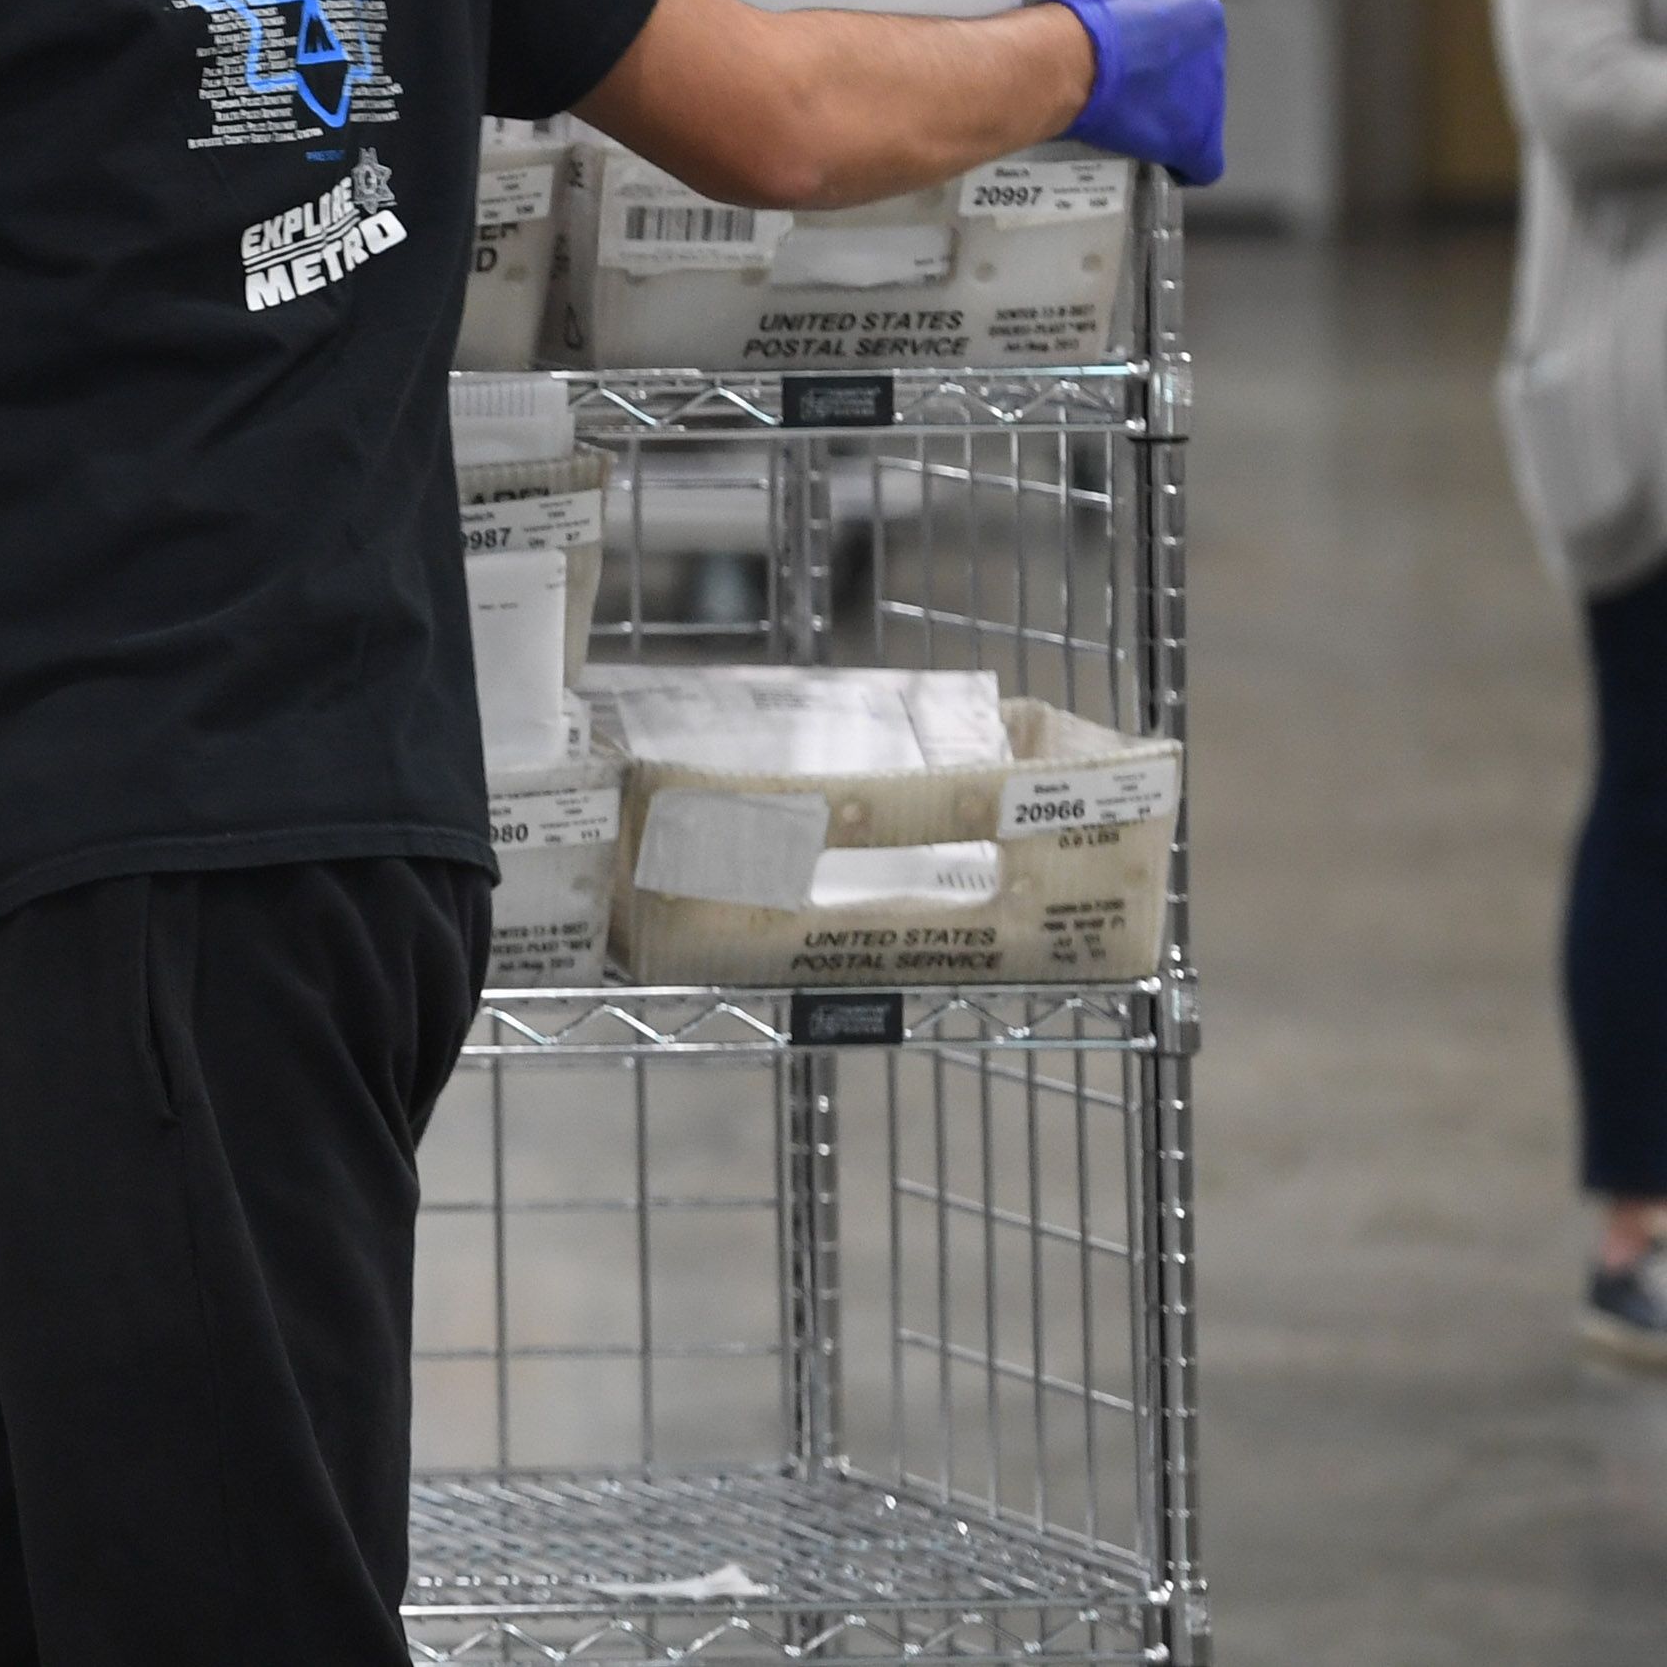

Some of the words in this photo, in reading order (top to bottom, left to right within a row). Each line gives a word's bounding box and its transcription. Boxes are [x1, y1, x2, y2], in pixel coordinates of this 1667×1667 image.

[973, 184, 1044, 207] 20997
[244, 209, 408, 312] METRO
[759, 312, 857, 332] UNITED
[862, 310, 964, 331] STATES
[742, 337, 846, 359] POSTAL
[855, 336, 970, 358] SERVICE
[1014, 798, 1086, 824] 20966
[804, 929, 898, 947] UNITED
[903, 927, 997, 946] STATES
[791, 952, 885, 971] POSTAL
[895, 951, 1005, 969] SERVICE
